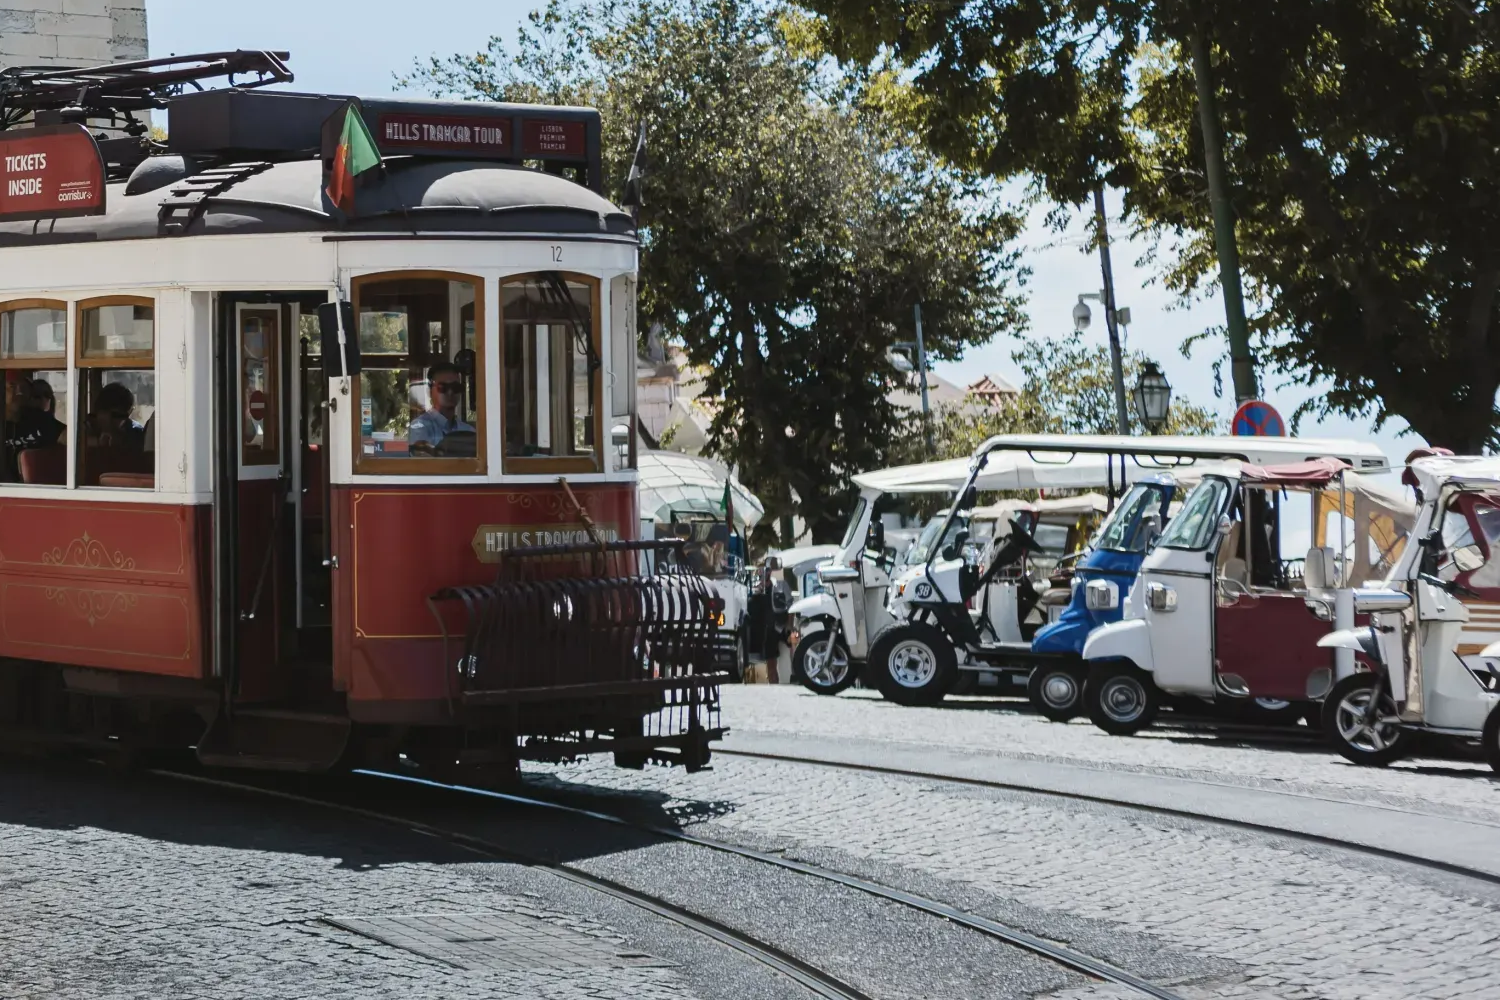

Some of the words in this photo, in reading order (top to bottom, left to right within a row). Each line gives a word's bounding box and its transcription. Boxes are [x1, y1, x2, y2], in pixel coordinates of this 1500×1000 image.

[386, 122, 420, 142] HILLS
[422, 124, 471, 144] TRAMCAR
[474, 126, 503, 145] TOUR
[541, 125, 563, 133] LISBON
[540, 134, 566, 142] PREMIUM
[540, 142, 566, 151] TRAMCAR
[5, 153, 47, 172] TICKETS
[8, 177, 42, 196] INSIDE
[550, 245, 563, 263] 12
[918, 584, 930, 597] 38
